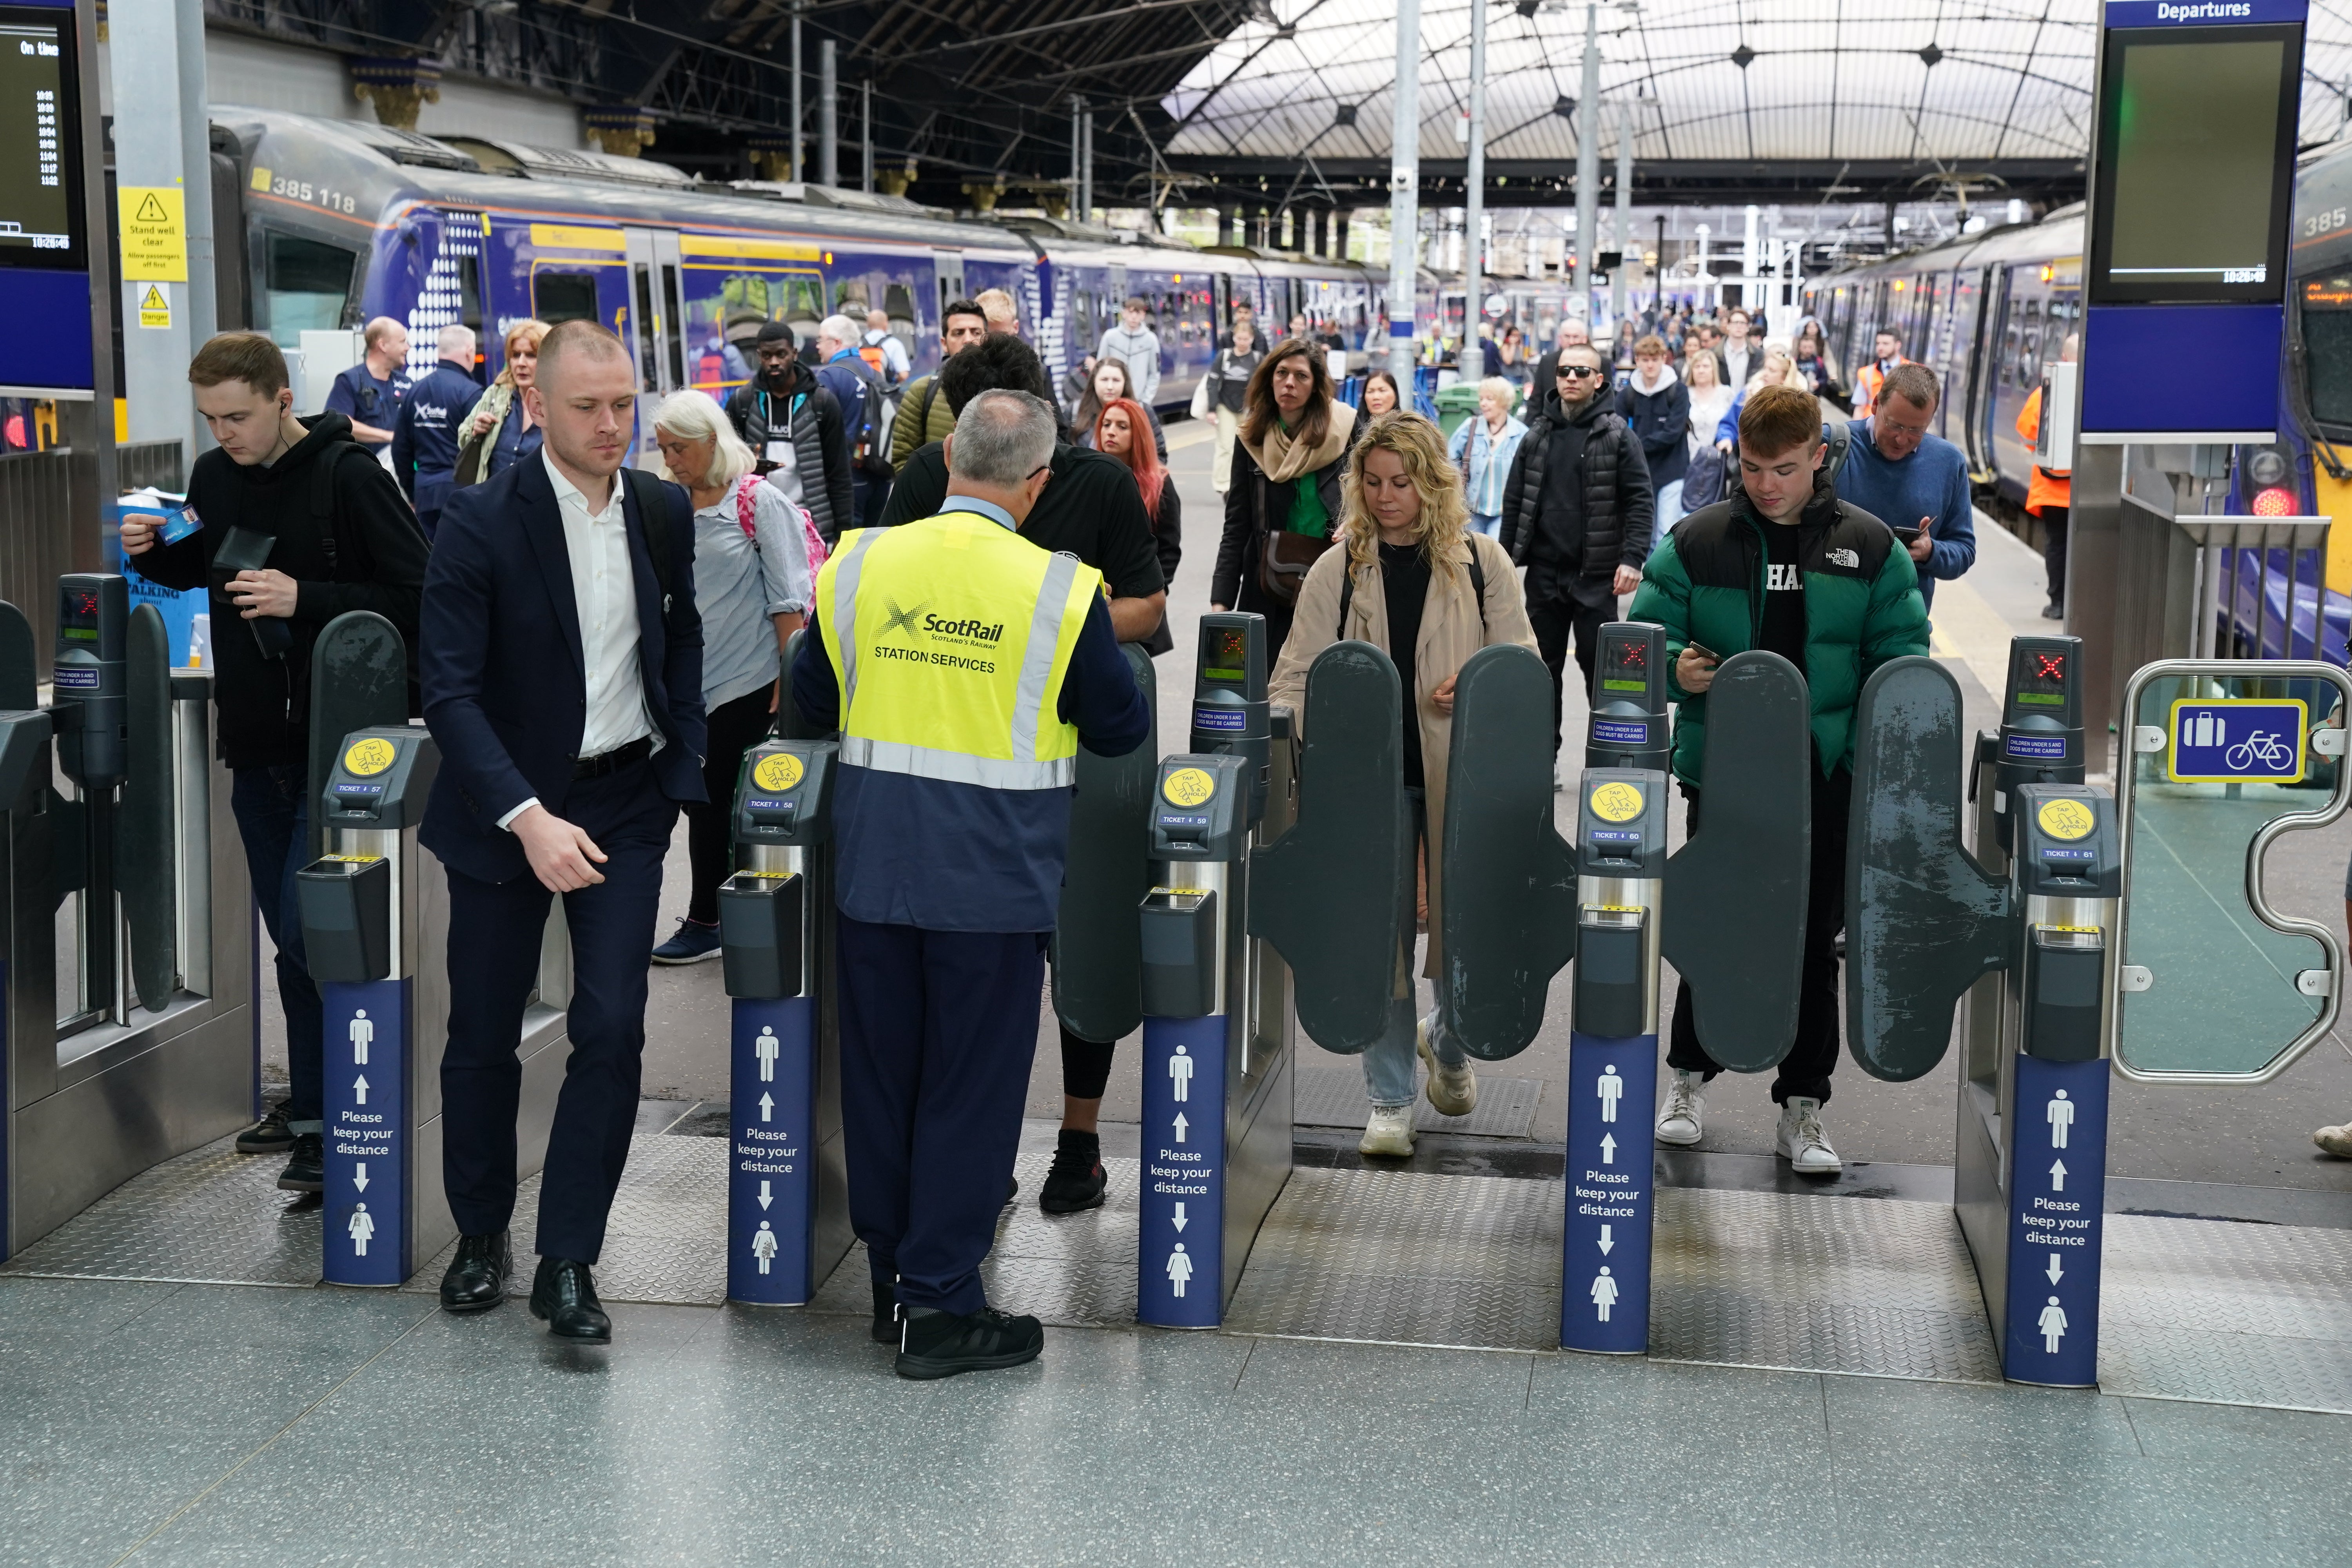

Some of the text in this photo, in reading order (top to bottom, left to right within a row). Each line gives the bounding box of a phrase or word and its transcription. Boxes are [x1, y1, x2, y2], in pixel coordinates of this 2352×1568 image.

[2158, 2, 2250, 22] Departures
[20, 40, 59, 56] On time
[39, 127, 56, 137] 10:54
[40, 151, 57, 162] 11:04
[41, 163, 58, 174] 11:17
[42, 175, 58, 185] 11:22
[273, 176, 355, 214] 385 118
[2305, 207, 2346, 236] 385
[130, 225, 175, 235] Stand well
[33, 237, 69, 249] 10:26:49
[143, 238, 163, 246] clear
[2223, 271, 2266, 283] 10:26:49
[142, 312, 168, 321] Danger
[1826, 552, 1848, 561] NORTH
[1766, 564, 1803, 591] HA
[129, 584, 180, 599] ALKING
[923, 613, 1004, 642] ScotRail
[931, 633, 997, 650] SCOTLAND'S RAILWAY
[875, 647, 995, 673] STATION SERVICES
[342, 1111, 383, 1122] Please
[334, 1126, 393, 1142] keep your
[747, 1128, 787, 1140] Please
[337, 1143, 388, 1155] distance
[738, 1143, 797, 1159] keep your
[1160, 1149, 1201, 1161] Please
[741, 1160, 792, 1173] distance
[1151, 1164, 1212, 1180] keep your
[1586, 1170, 1629, 1183] Please
[1154, 1181, 1207, 1194] distance
[1575, 1185, 1639, 1202] keep your
[1579, 1203, 1634, 1217] distance
[2034, 1197, 2080, 1211] Please
[2022, 1212, 2091, 1230] keep your
[2026, 1231, 2085, 1246] distance
